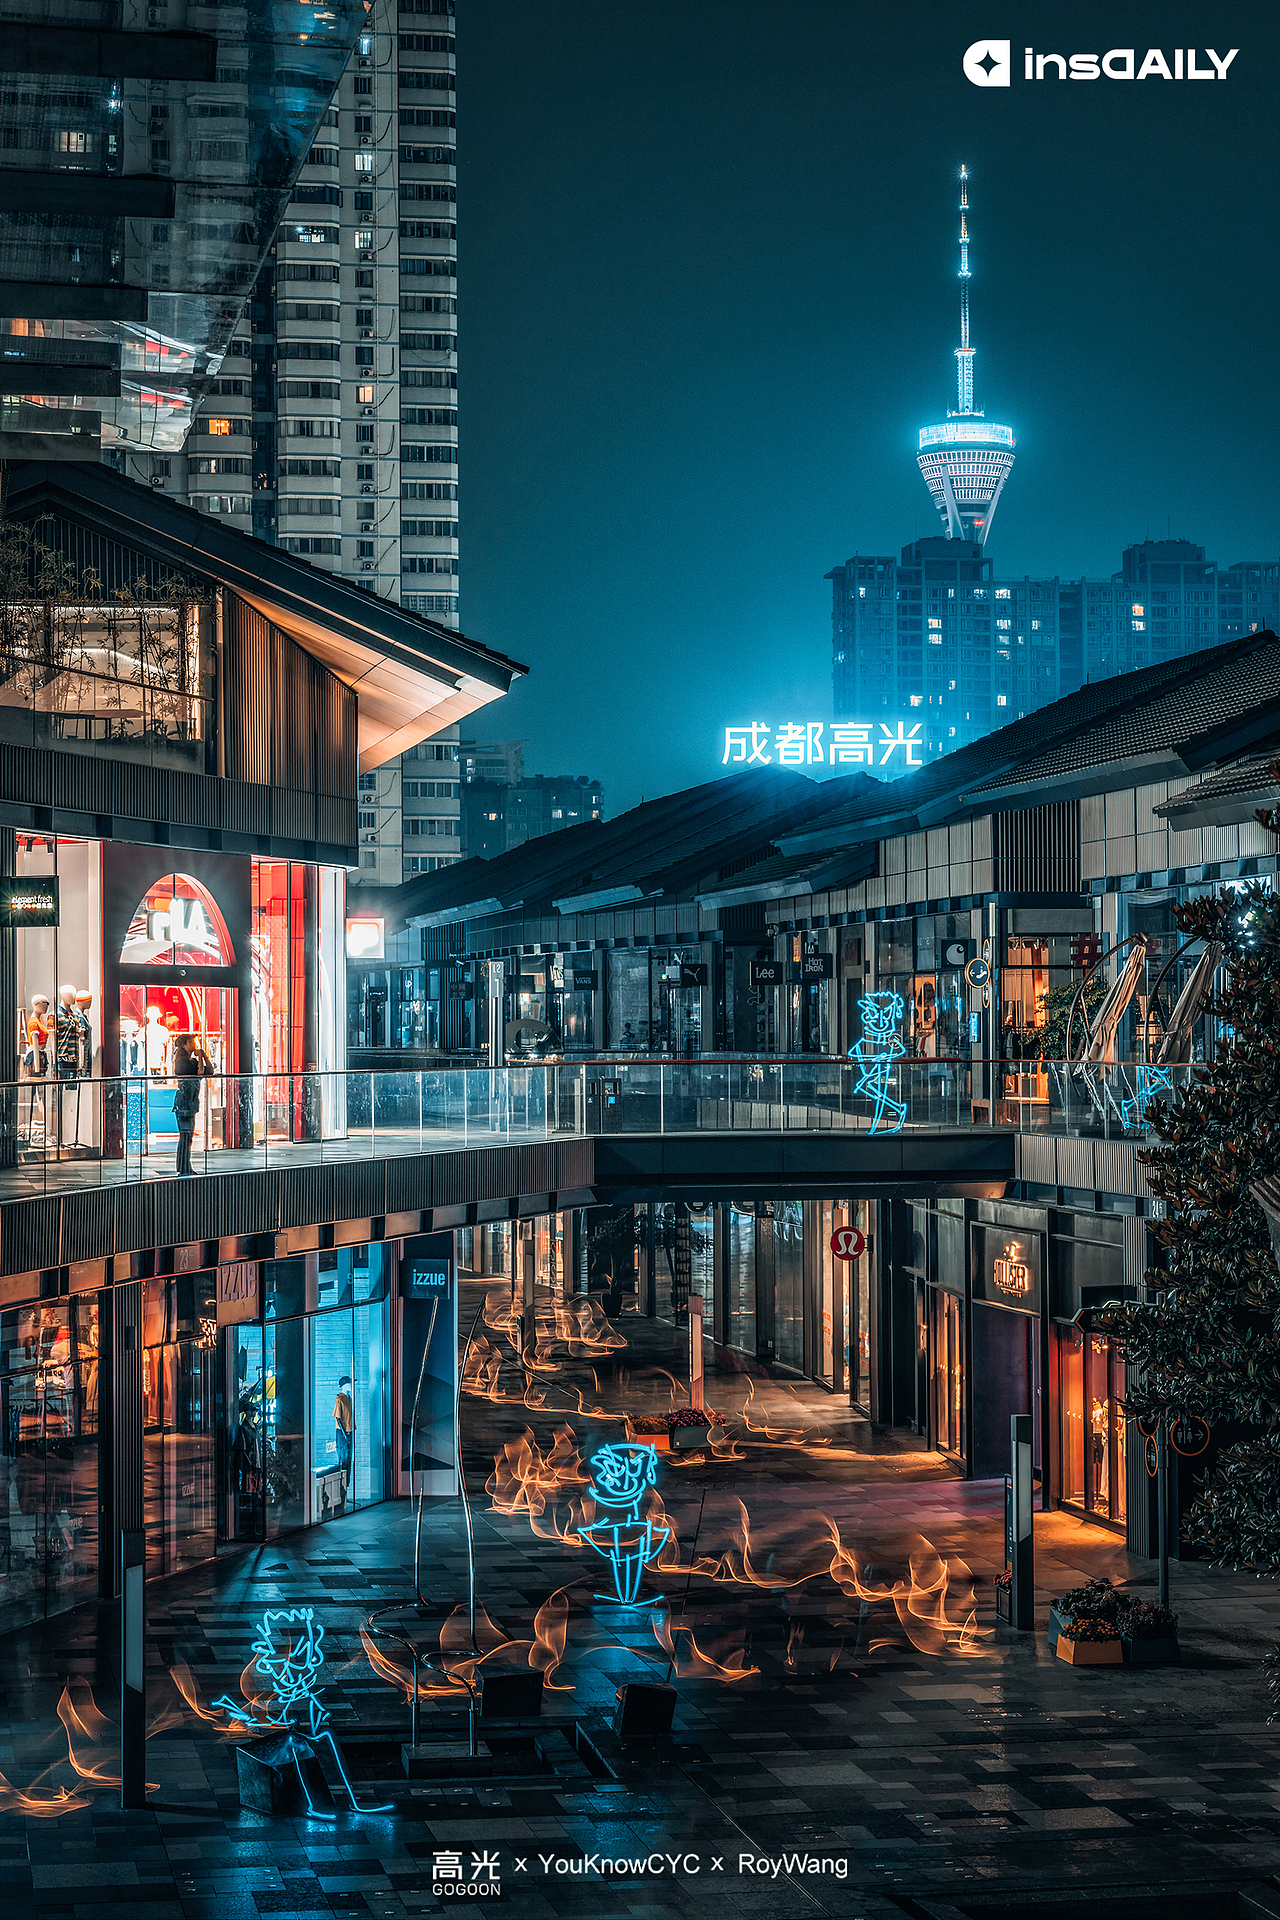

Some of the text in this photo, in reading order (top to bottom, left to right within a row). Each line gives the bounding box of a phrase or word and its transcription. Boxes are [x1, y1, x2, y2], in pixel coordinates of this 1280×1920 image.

[721, 720, 923, 765] 成都高光
[37, 895, 53, 903] fresh
[755, 967, 775, 979] Lee
[575, 976, 592, 985] VANS
[412, 1268, 446, 1286] izzue
